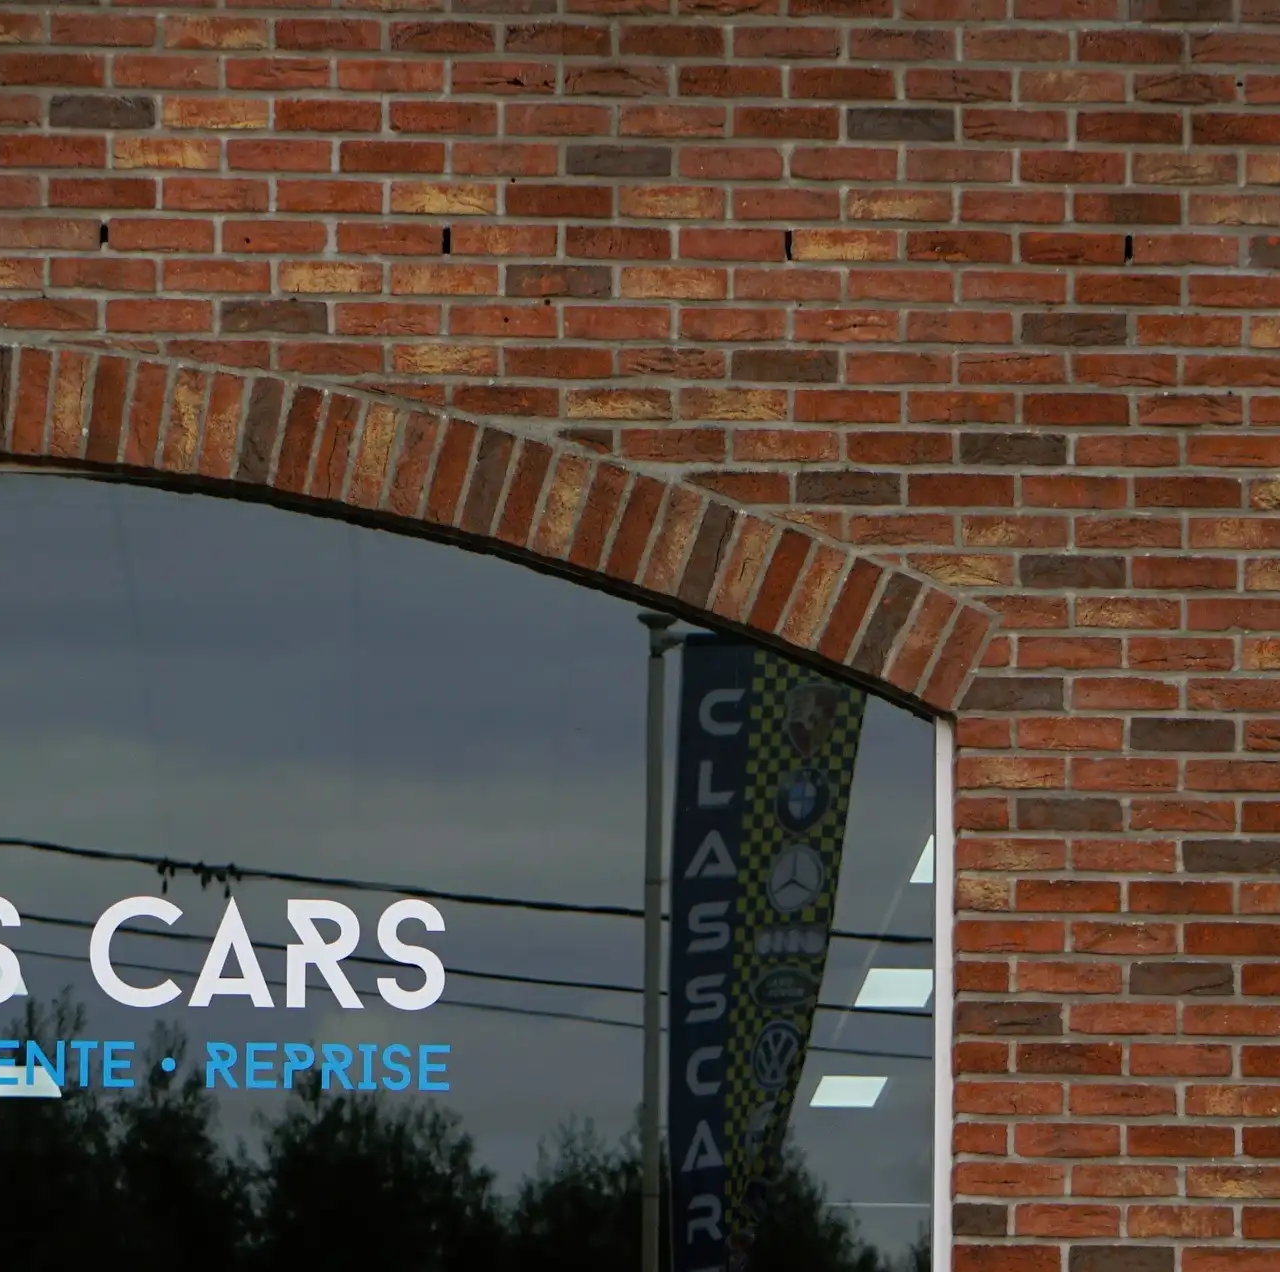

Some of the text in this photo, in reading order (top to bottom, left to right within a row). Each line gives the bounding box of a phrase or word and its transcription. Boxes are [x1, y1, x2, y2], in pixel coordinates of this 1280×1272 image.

[682, 687, 747, 1025] CLASS
[89, 896, 446, 1011] CARS
[202, 1041, 453, 1093] REPRISE
